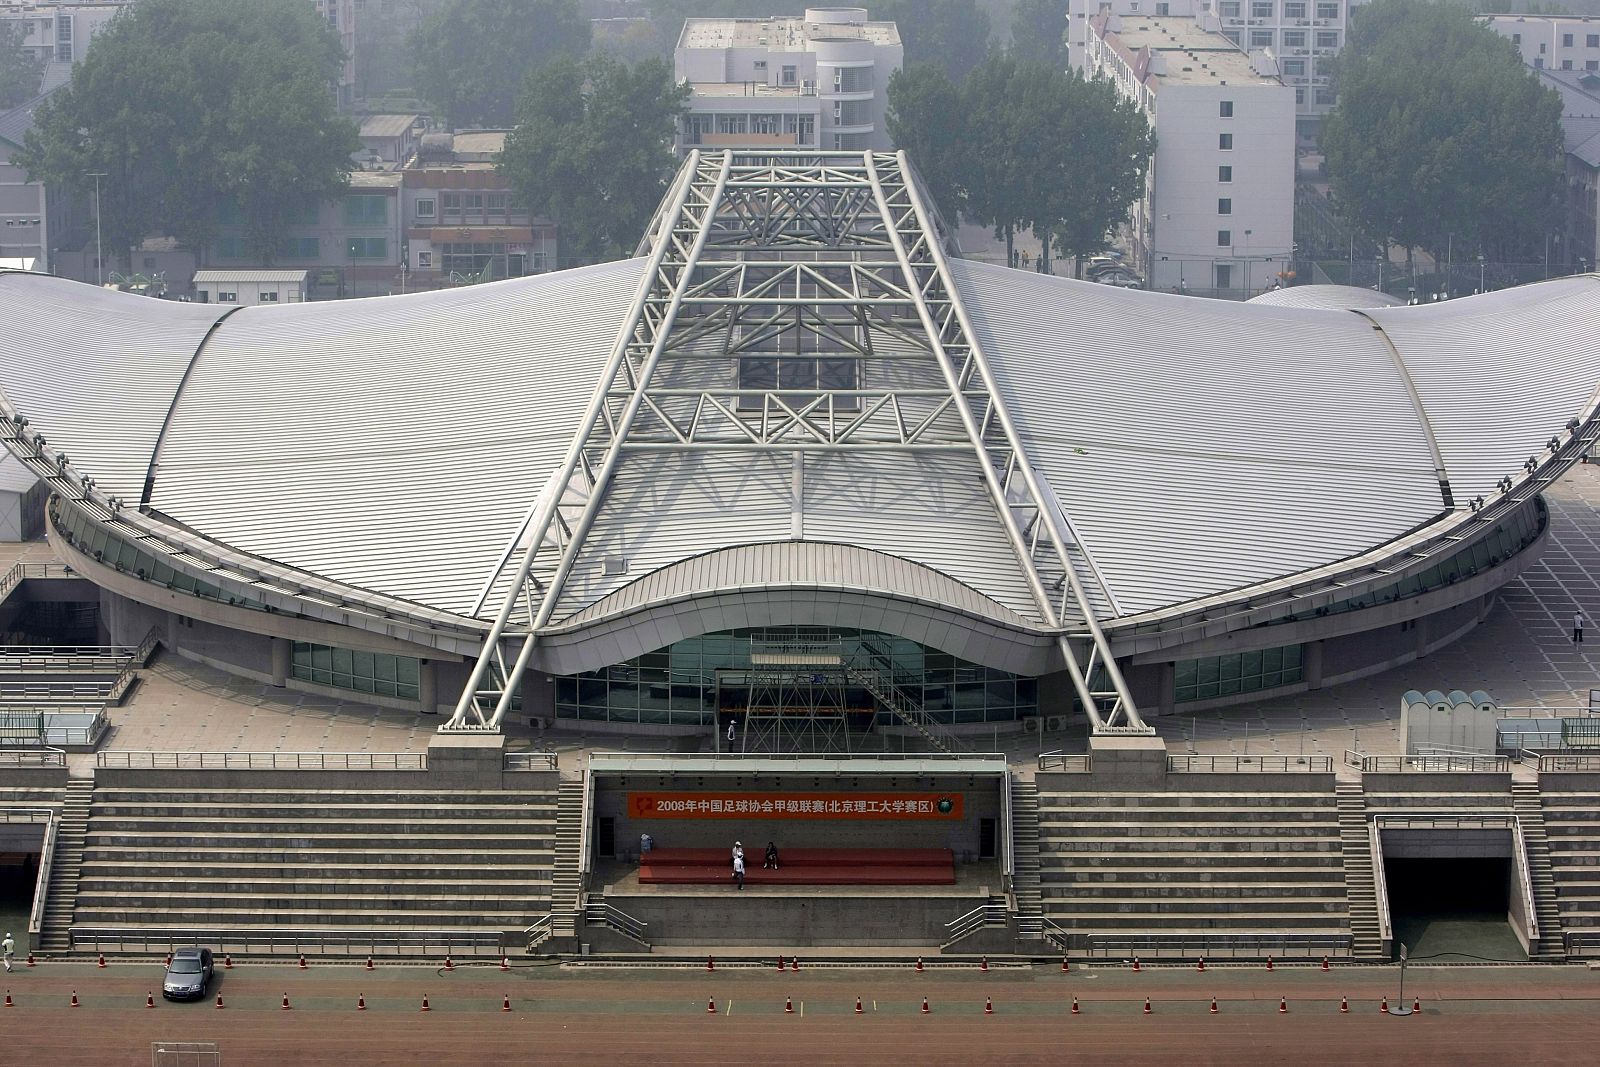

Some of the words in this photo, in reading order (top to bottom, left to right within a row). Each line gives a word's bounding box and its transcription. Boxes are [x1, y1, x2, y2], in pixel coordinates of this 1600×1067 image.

[656, 799, 934, 813] 2008年中国足球协会甲级联赛(北京理工大学赛区)
